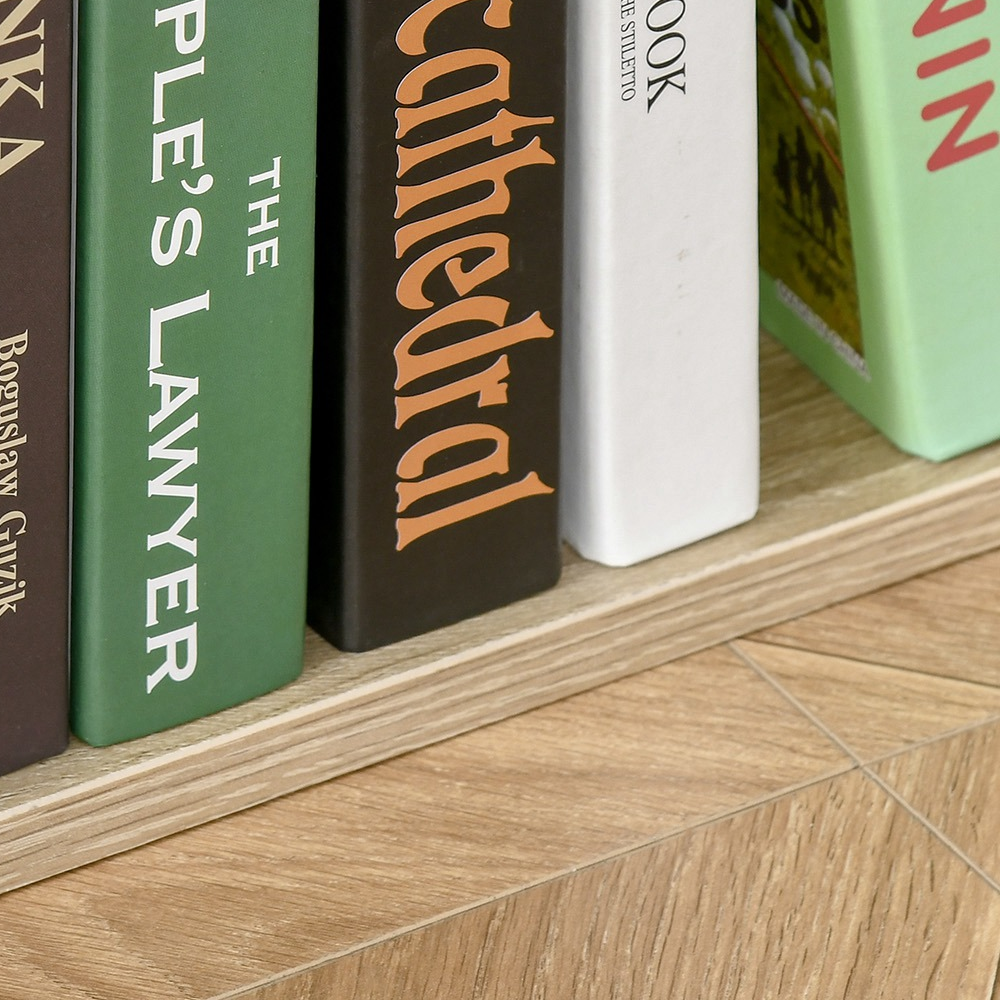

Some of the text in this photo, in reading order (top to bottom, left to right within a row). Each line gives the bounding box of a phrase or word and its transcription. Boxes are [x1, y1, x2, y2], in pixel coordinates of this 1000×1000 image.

[619, 20, 637, 102] STILETTO
[244, 154, 283, 278] THE
[144, 288, 213, 695] LAWYER
